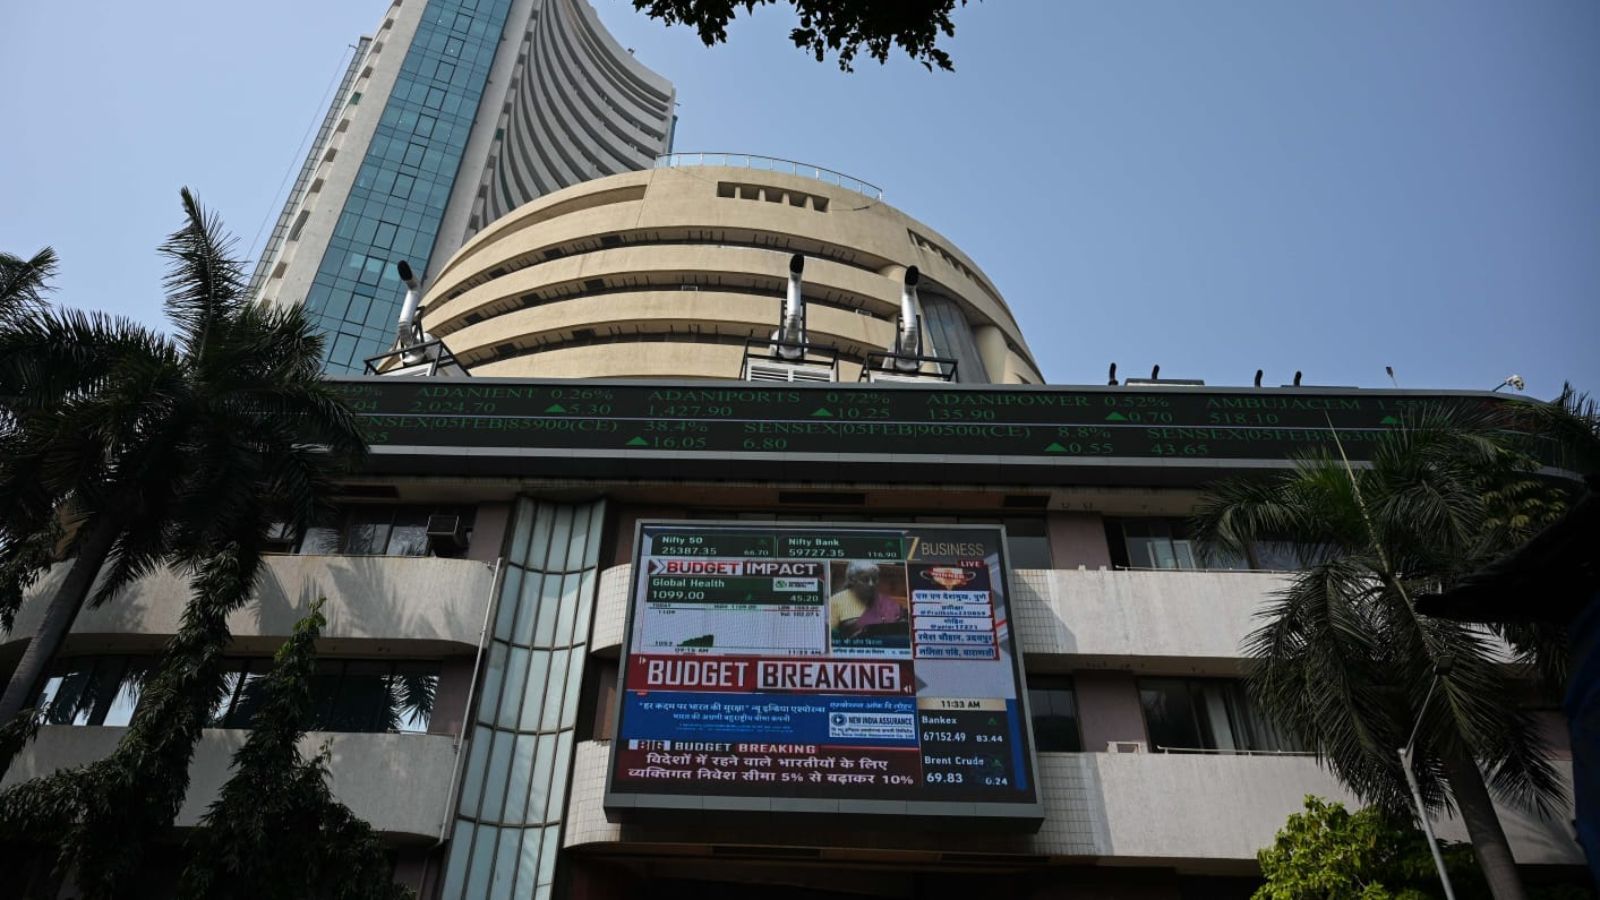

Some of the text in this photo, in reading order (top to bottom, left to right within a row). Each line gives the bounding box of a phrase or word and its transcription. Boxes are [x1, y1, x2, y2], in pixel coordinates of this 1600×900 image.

[416, 387, 534, 398] ADANIENT
[551, 388, 613, 400] 0.26%
[649, 391, 800, 403] ADANIPORTS
[827, 393, 890, 404] 0.72%
[927, 394, 1089, 406] ADANIPOWER
[1104, 396, 1169, 407] 0.52%
[410, 401, 496, 413] 2,024.70
[568, 404, 611, 415] 5.30
[648, 406, 732, 417] 1,427.90
[838, 408, 890, 418] 10.25
[1128, 412, 1173, 423] 0.70
[644, 421, 708, 432] 38.4%
[1058, 427, 1111, 439] 8.8%
[654, 437, 706, 448] 16.05
[744, 438, 787, 449] 6.80
[1069, 443, 1113, 454] 0.55
[1152, 444, 1208, 455] 43.65
[662, 536, 703, 545] Nifty 50
[788, 538, 840, 547] Nifty Bank
[662, 546, 717, 555] 25387.35
[789, 548, 845, 557] 59727.35
[921, 542, 984, 556] BUSINESS
[667, 561, 818, 575] BUDGET IMPACT
[960, 560, 981, 568] LIVE
[652, 578, 725, 588] Global Health
[652, 590, 705, 600] 1099.00
[648, 660, 896, 690] BUDGET BREAKING
[941, 700, 965, 708] 11:33
[863, 716, 878, 724] INDIA
[880, 717, 912, 725] ASSURANCE
[922, 715, 957, 724] Bankex
[923, 732, 966, 742] 67152.49
[675, 742, 816, 754] BUDGET BREAKING
[646, 752, 889, 771] विदेशों में रहने वाले भारतीयों के लिए
[924, 756, 985, 765] Brent Crude
[628, 766, 692, 779] व्यक्तिगत
[697, 767, 737, 780] निवेश
[742, 769, 777, 781] सीमा
[781, 772, 803, 782] 5%
[809, 770, 822, 782] से
[882, 775, 914, 785] 10%
[926, 772, 1008, 786] 69.83 0.24
